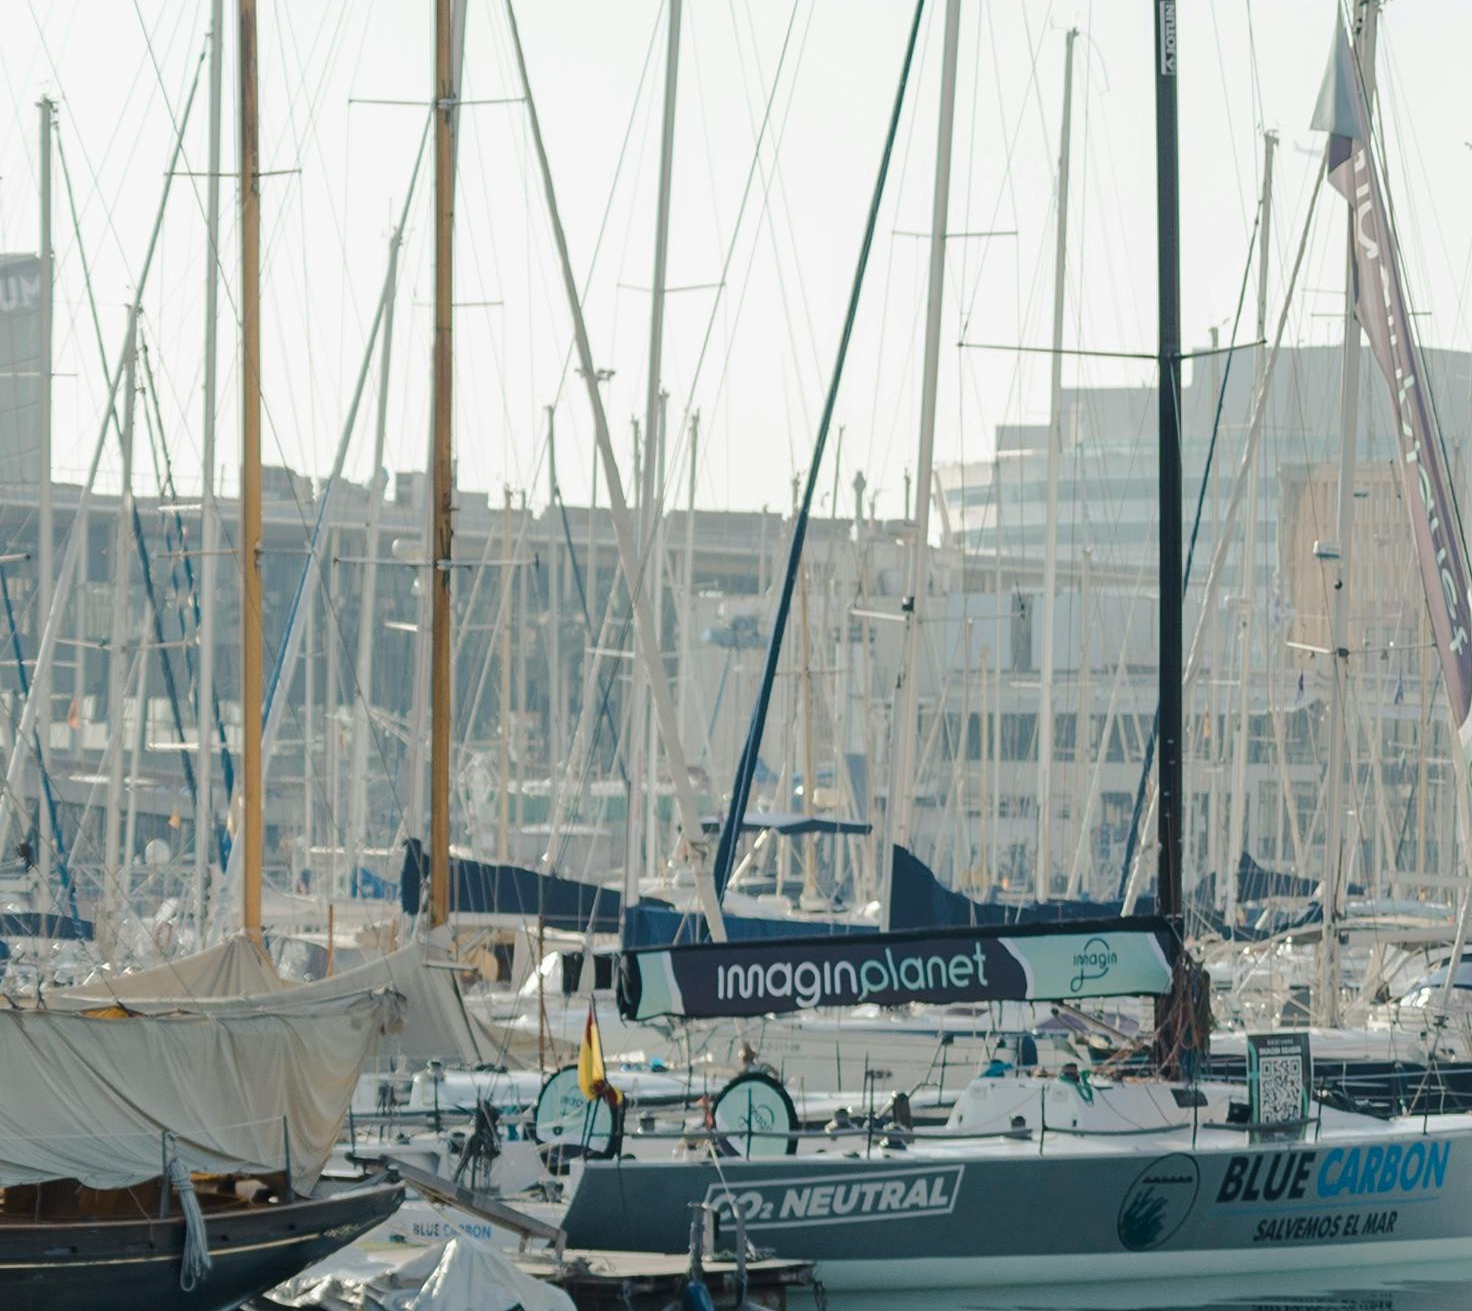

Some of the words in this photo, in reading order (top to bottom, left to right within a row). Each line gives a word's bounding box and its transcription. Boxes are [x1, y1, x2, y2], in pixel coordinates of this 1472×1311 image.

[717, 942, 988, 1008] imaginplanet
[1072, 951, 1118, 970] imagin
[1215, 1151, 1317, 1203] BLUE
[1316, 1140, 1452, 1199] CARBON
[779, 1176, 949, 1219] NEUTRAL
[412, 1222, 439, 1237] BLUE
[1253, 1215, 1341, 1242] SALVEMOS
[1342, 1213, 1361, 1236] EL
[1361, 1210, 1398, 1235] MAR
